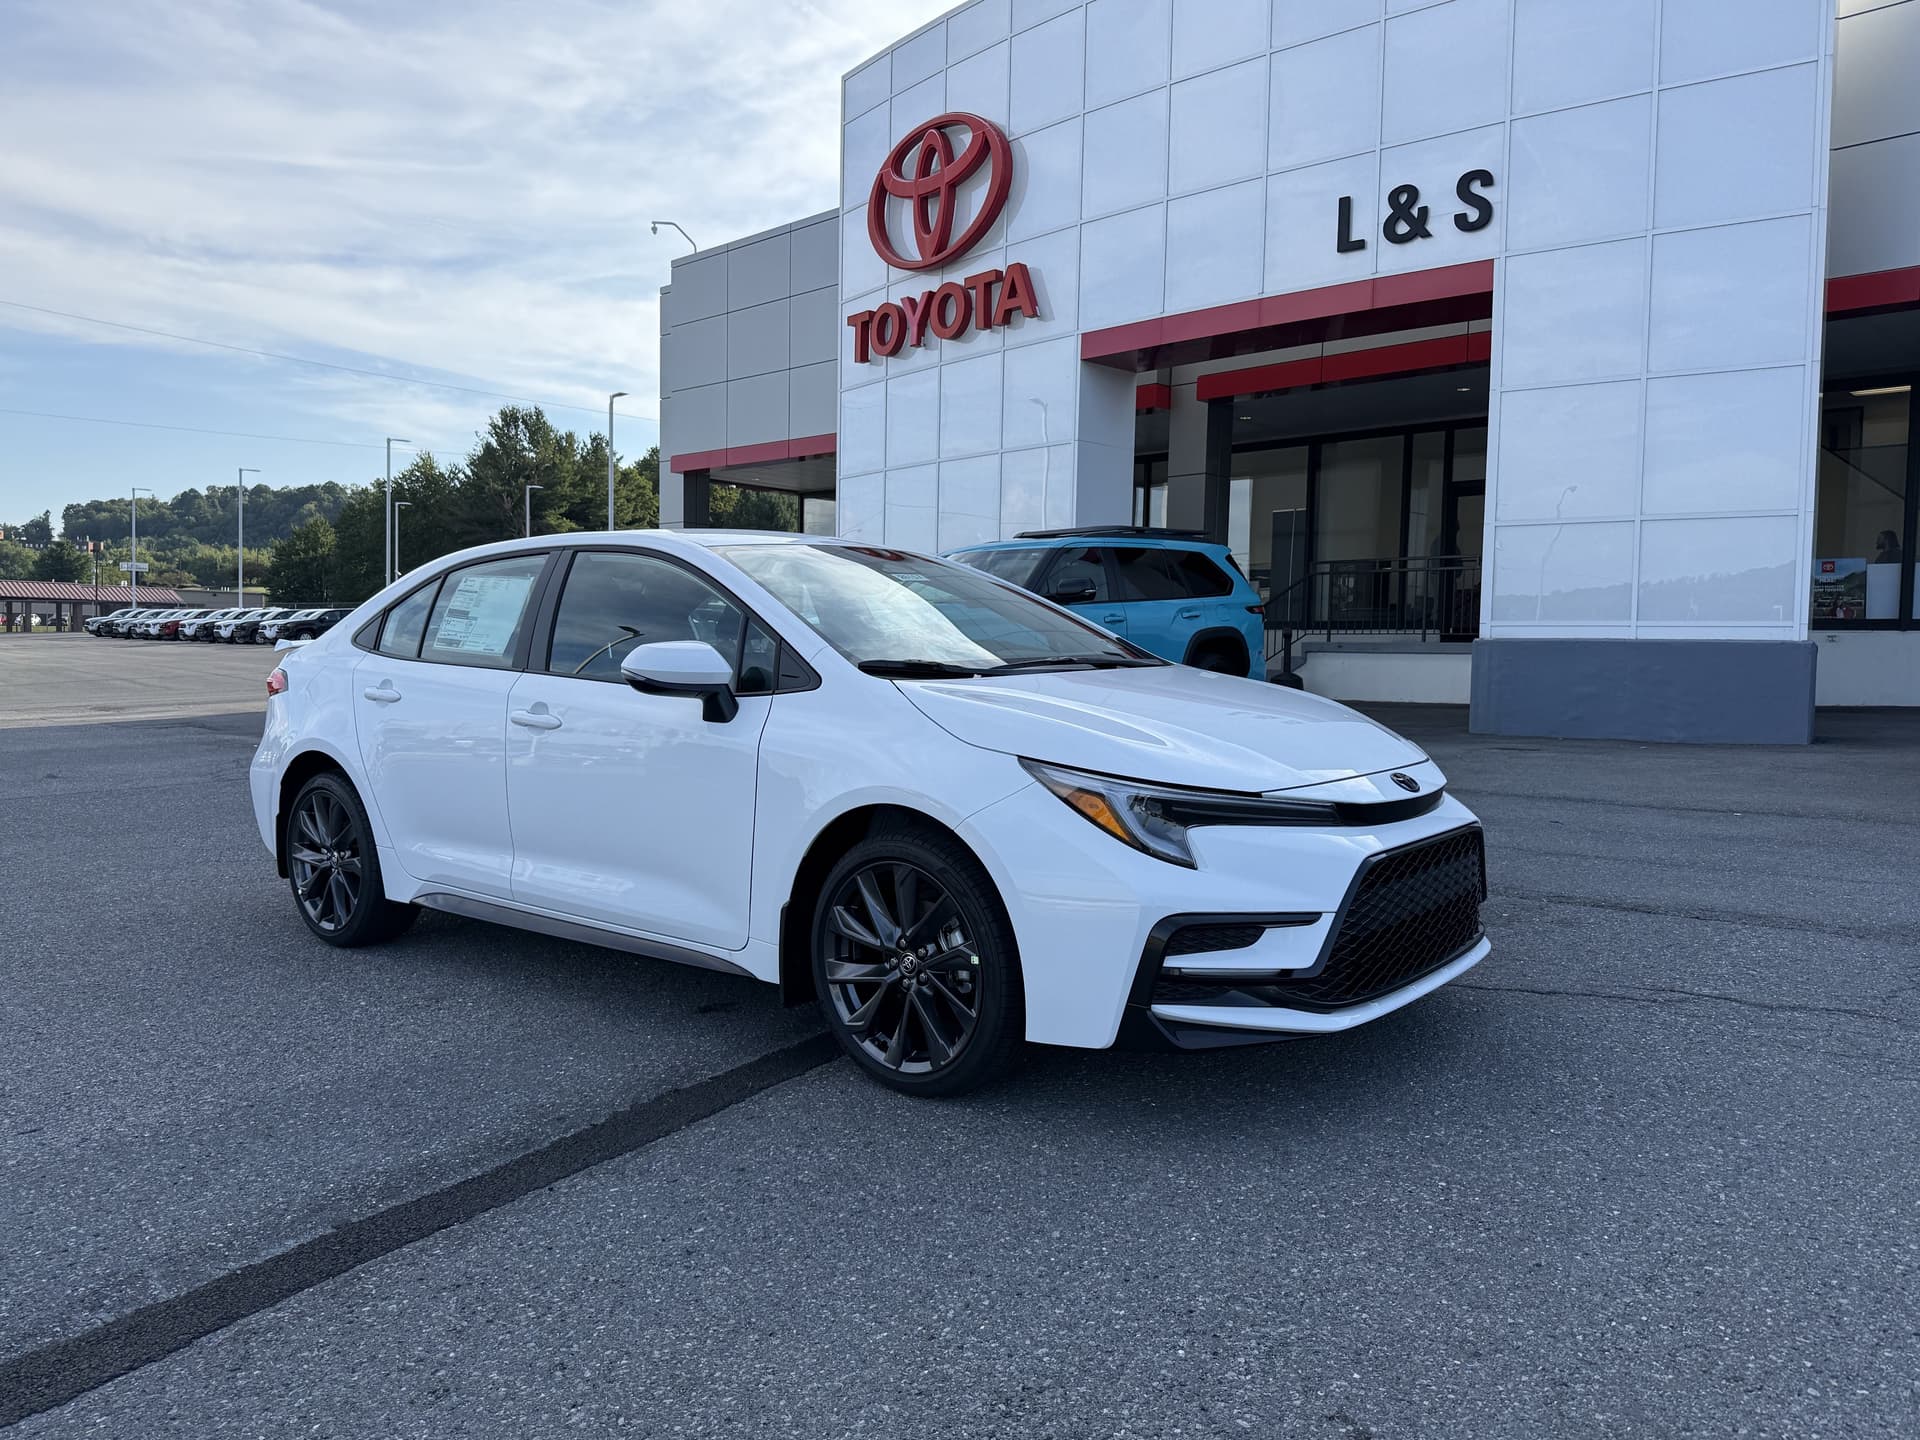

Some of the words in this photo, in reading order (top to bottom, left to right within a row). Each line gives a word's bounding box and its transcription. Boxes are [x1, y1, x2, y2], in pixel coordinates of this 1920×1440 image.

[1337, 196, 1366, 253] L
[1383, 184, 1433, 244] &
[1454, 169, 1495, 232] S
[848, 262, 1039, 363] TOYOTA
